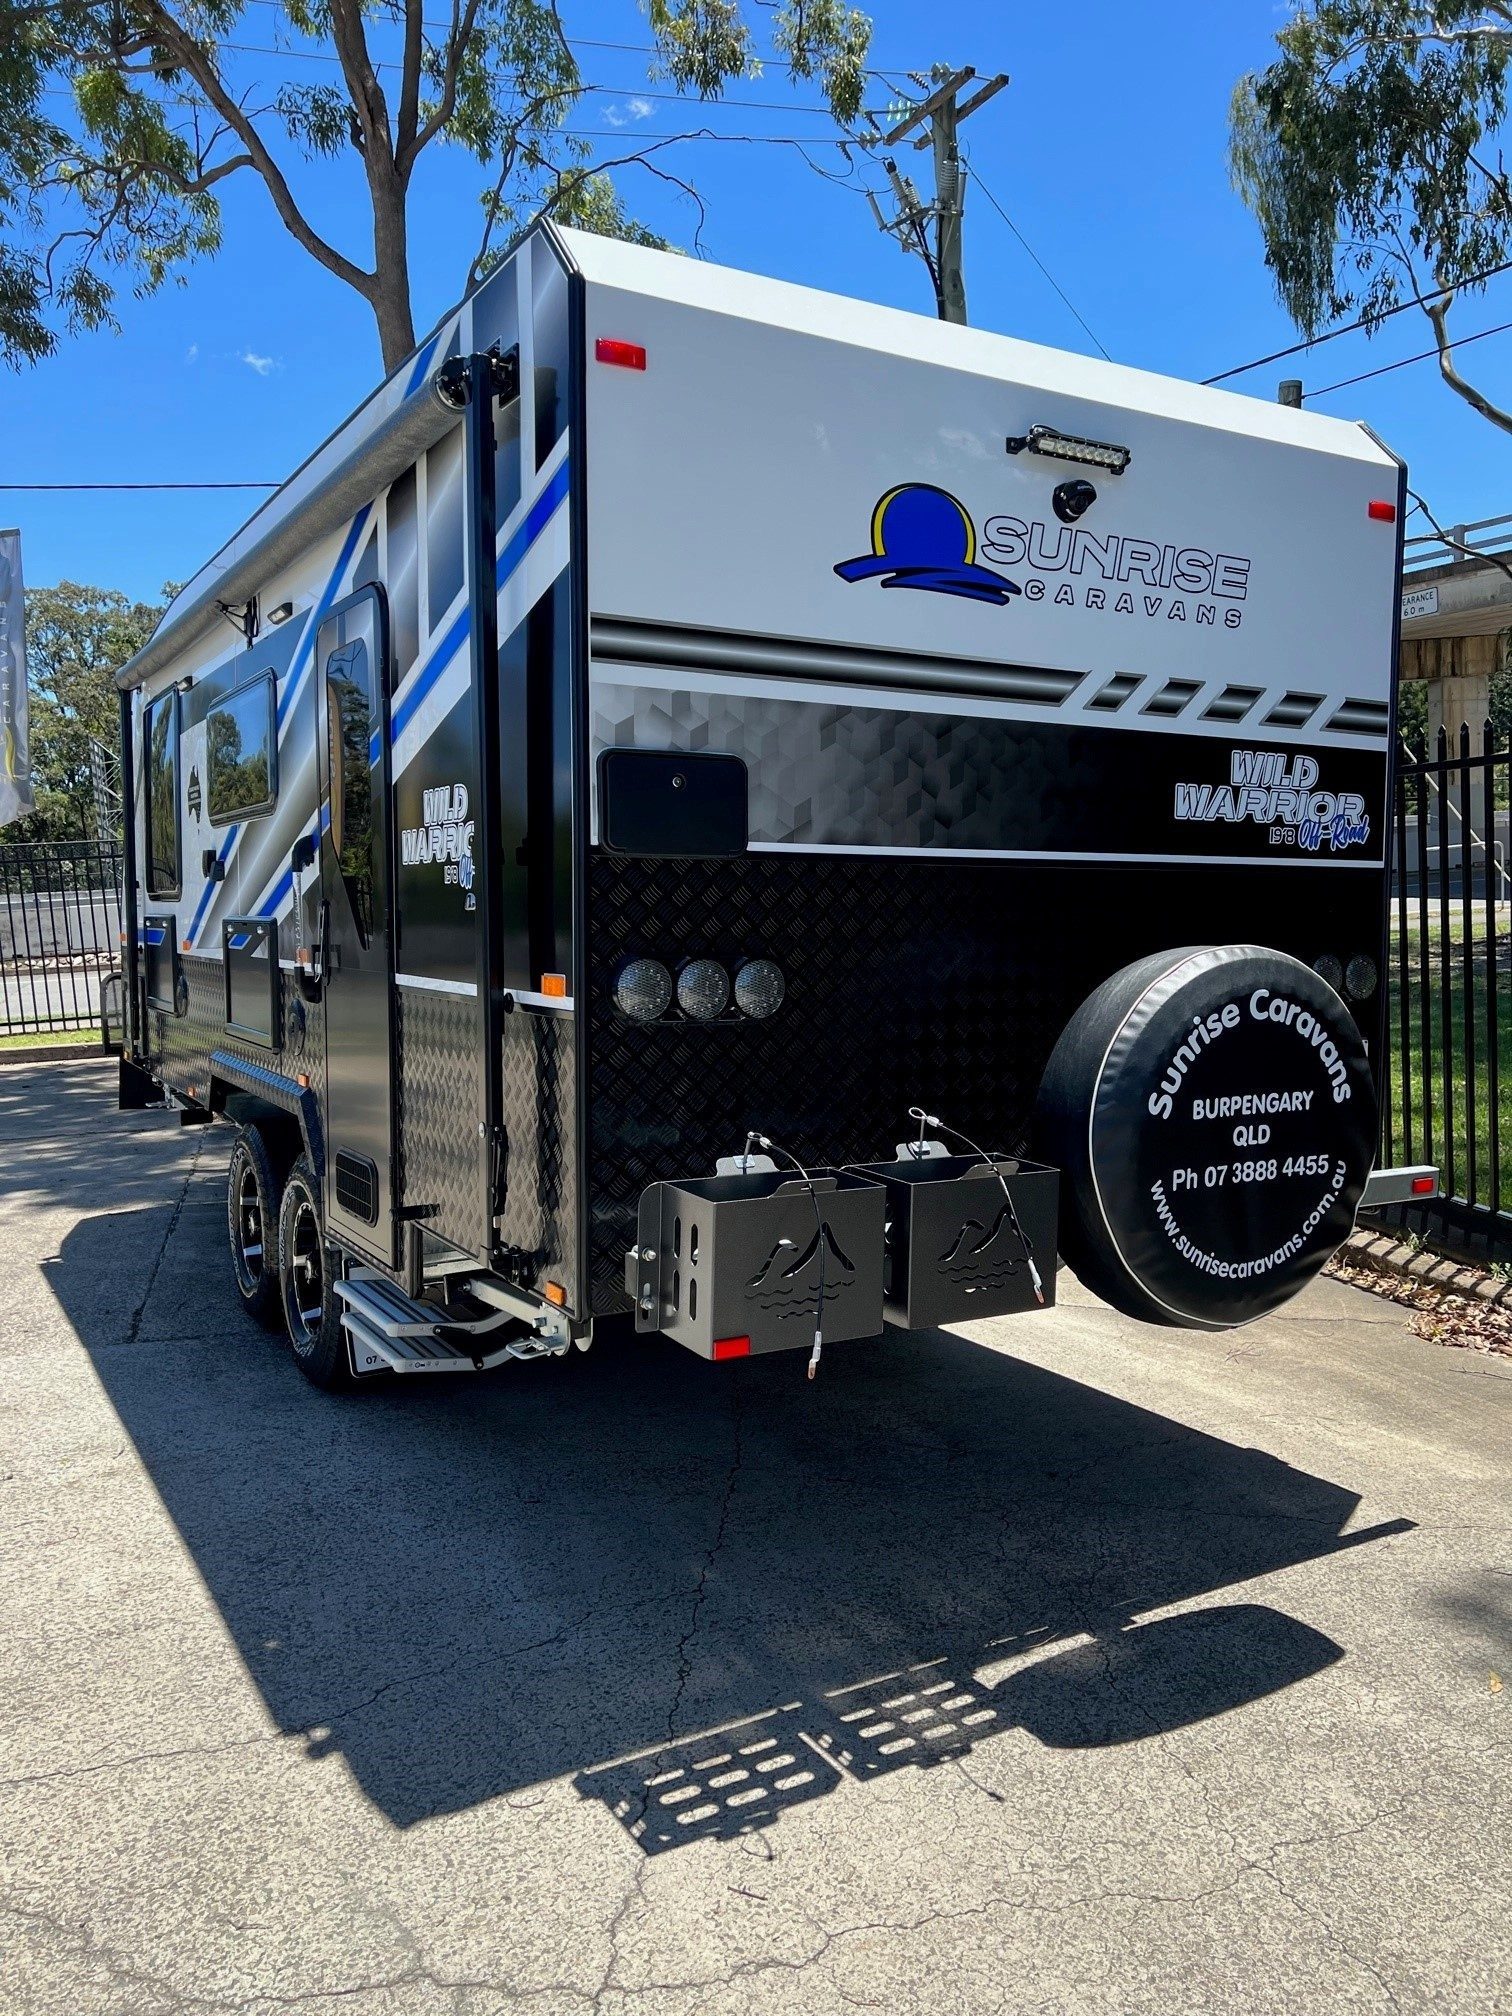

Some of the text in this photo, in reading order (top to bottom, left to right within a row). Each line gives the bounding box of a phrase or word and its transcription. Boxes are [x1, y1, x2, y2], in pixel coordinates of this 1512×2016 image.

[981, 515, 1251, 600] SUNRISE
[1025, 579, 1242, 628] CARAVANS
[1231, 750, 1319, 790] WILD
[423, 783, 469, 826] WILD
[1174, 783, 1365, 825] WARRIOR
[1298, 813, 1370, 851] Off-Road
[1148, 988, 1352, 1120] Sunrise Caravans
[1193, 1090, 1314, 1120] BURPENGARY
[1232, 1124, 1271, 1147] QLD
[1172, 1153, 1329, 1191] Ph 07 3888 4455
[1150, 1159, 1347, 1279] www.sunrisecaravans.com.au
